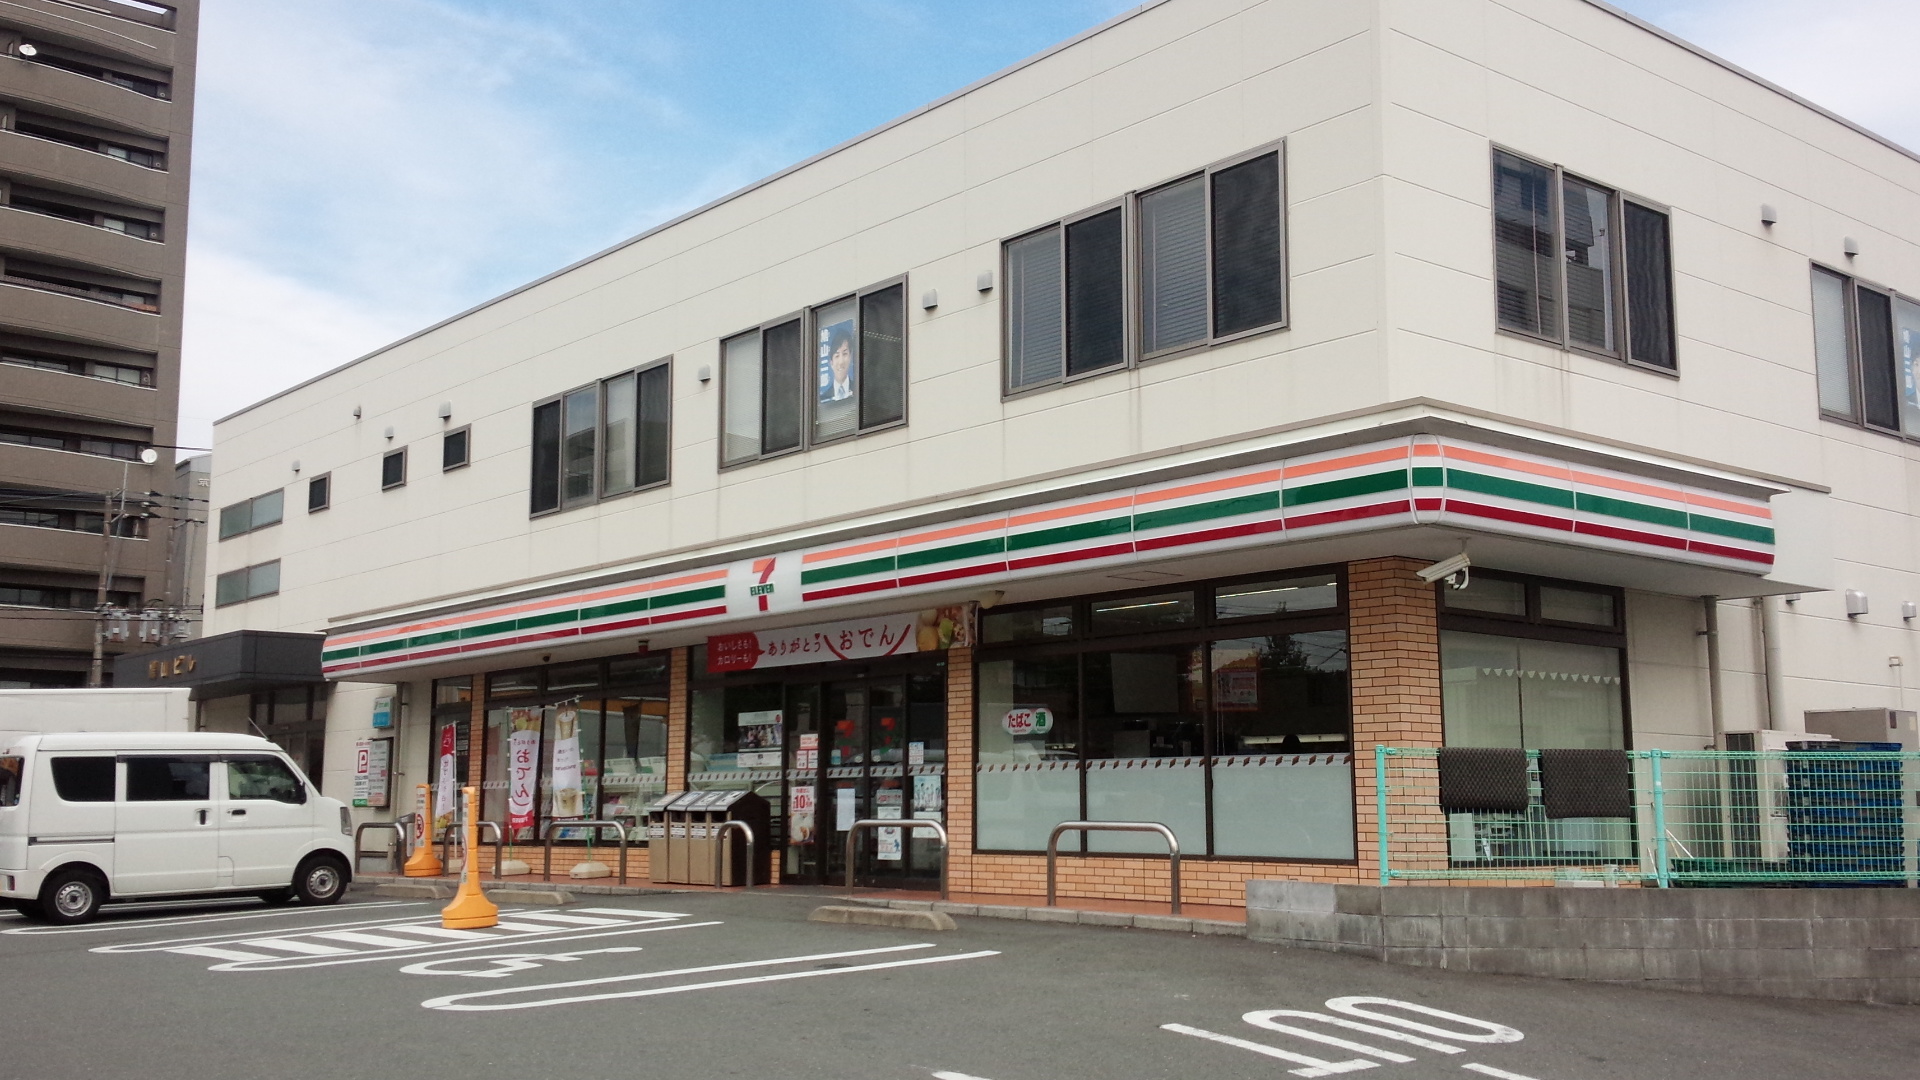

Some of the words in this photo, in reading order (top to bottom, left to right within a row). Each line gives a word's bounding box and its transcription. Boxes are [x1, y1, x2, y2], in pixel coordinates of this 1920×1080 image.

[752, 557, 777, 612] 7
[768, 637, 821, 657] ありがとう
[839, 624, 896, 651] おでん
[1008, 713, 1032, 728] たばこ
[1035, 711, 1046, 727] 酒
